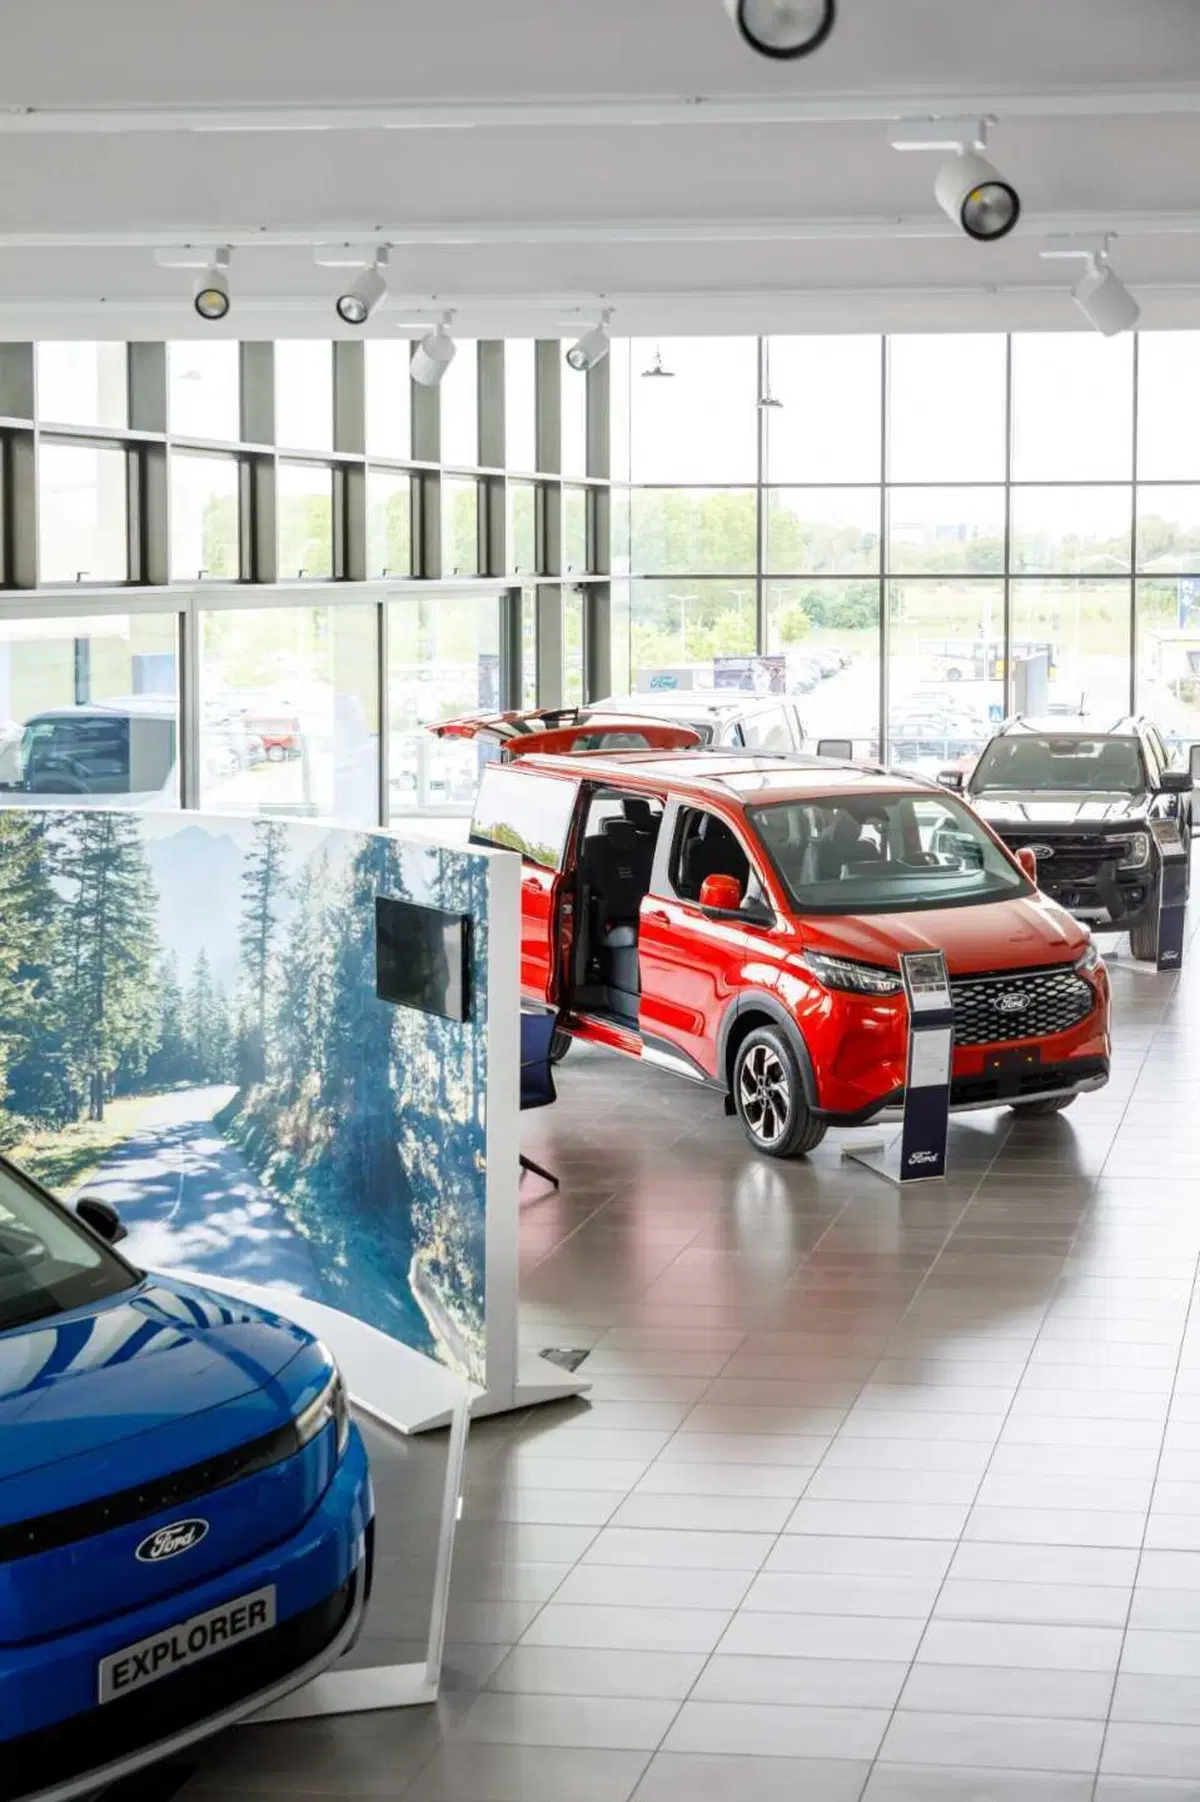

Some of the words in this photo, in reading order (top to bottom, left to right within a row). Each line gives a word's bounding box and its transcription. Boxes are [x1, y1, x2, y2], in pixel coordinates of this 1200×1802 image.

[1160, 950, 1179, 961] Ford
[1000, 996, 1023, 1010] Ford
[908, 1150, 938, 1165] Ford
[150, 1525, 195, 1557] Ford
[112, 1598, 266, 1690] EXPLORER
